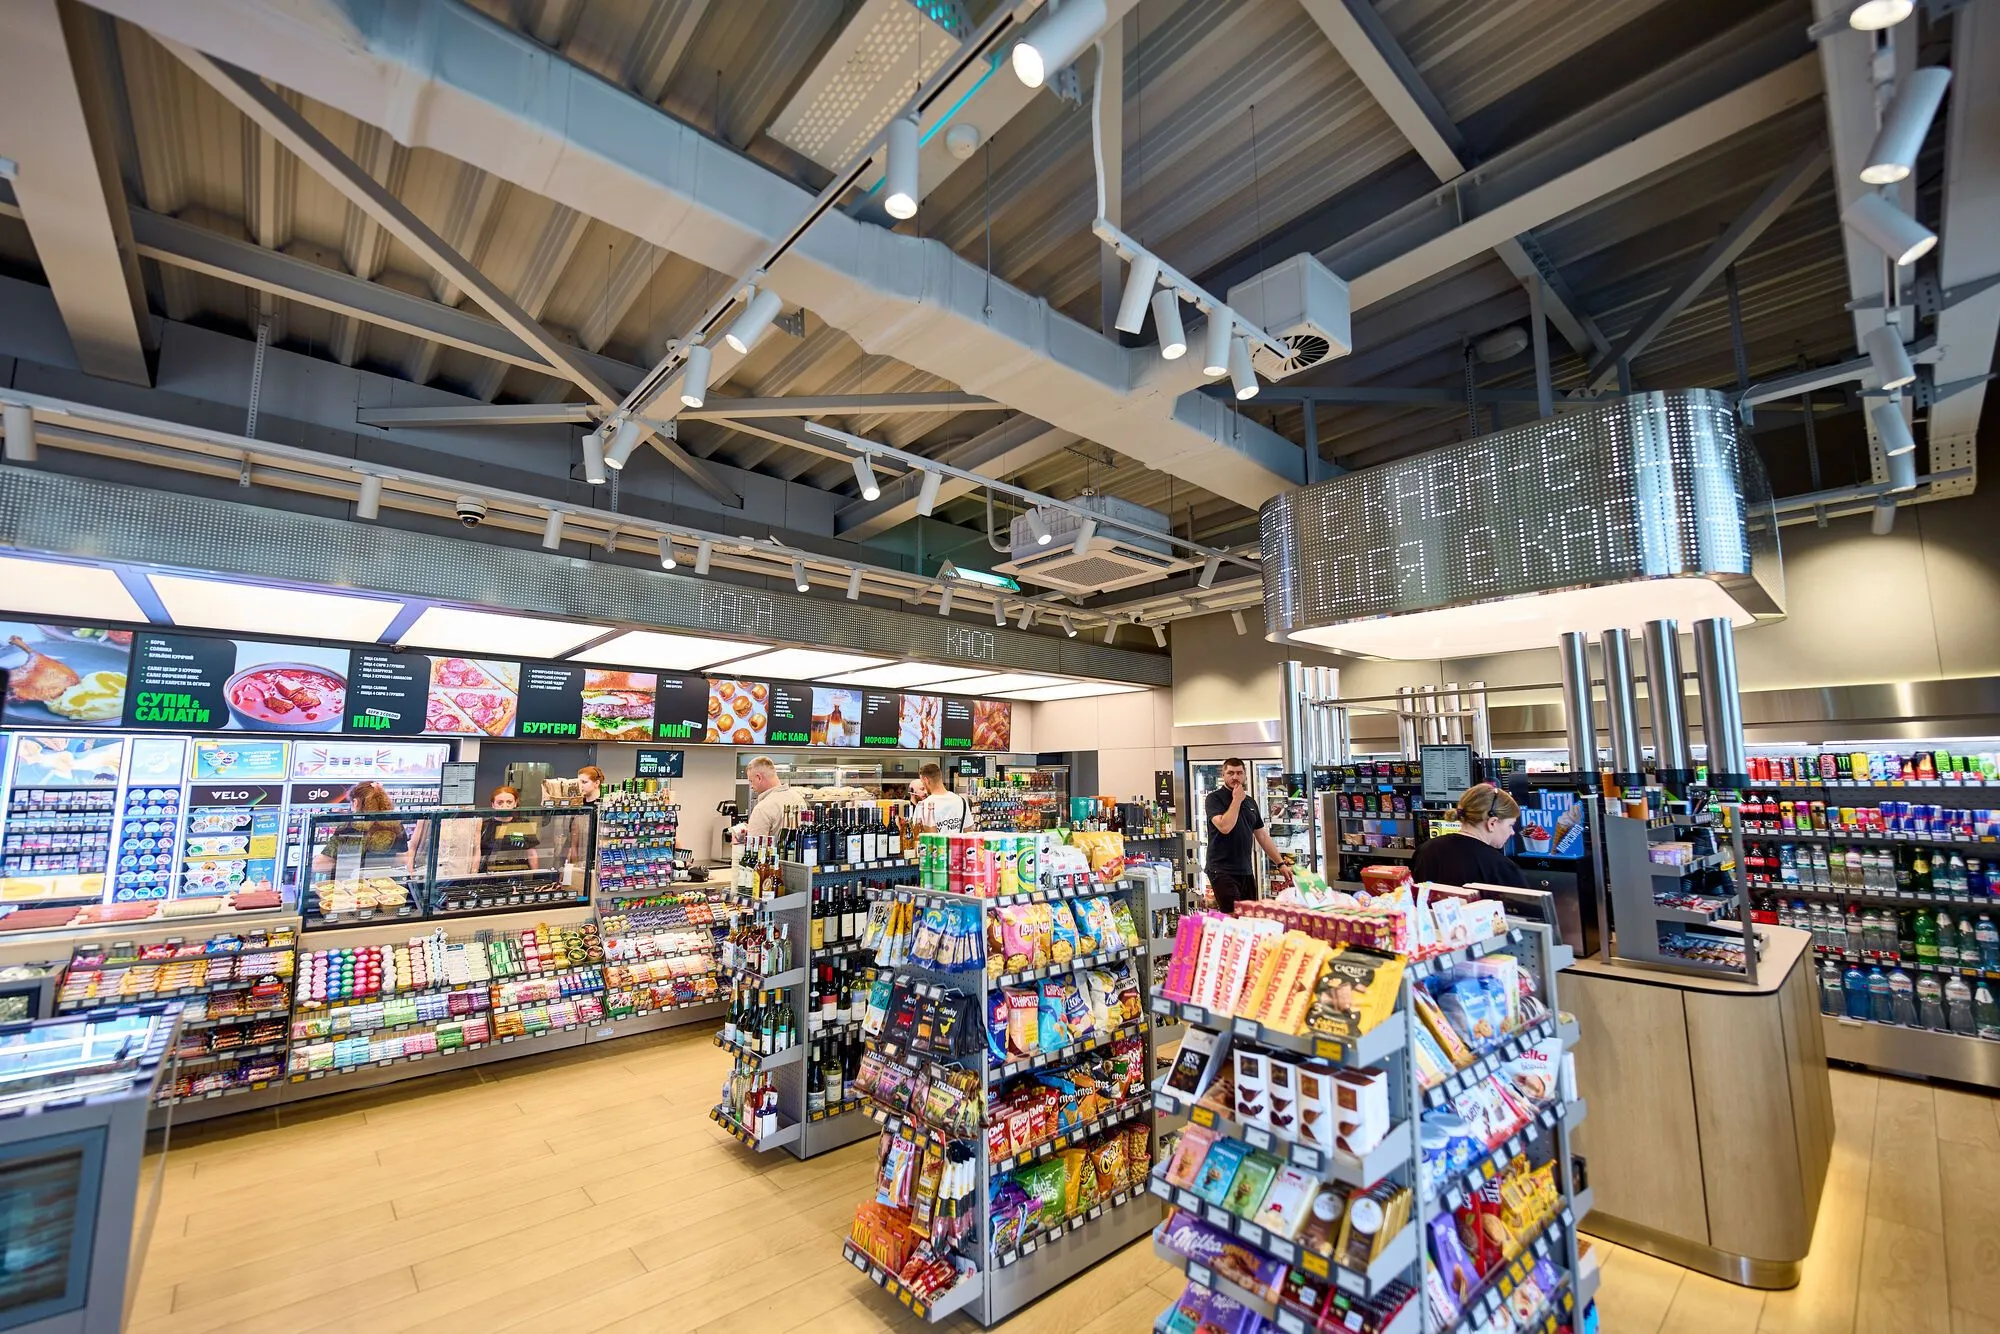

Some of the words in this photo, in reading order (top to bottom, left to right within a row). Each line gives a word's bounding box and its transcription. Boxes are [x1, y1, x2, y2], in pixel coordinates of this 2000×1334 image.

[1363, 449, 1499, 532] КАВА
[1313, 540, 1427, 610] ІДЕЯ
[1518, 491, 1697, 577] КАВА
[700, 587, 773, 630] КАСА
[947, 626, 995, 660] КАСА
[137, 692, 191, 708] СУПИ
[191, 700, 200, 708] &
[135, 707, 210, 723] САЛАТИ
[353, 715, 391, 730] ПІЦА
[523, 721, 577, 735] БУРГЕРИ
[660, 723, 691, 738] МІНІ
[771, 731, 787, 741] АЙС
[788, 732, 809, 742] КАВА
[864, 736, 897, 745] МОРОЗИВО
[944, 738, 972, 747] ВИПІЧКА
[211, 791, 249, 800] VELO
[308, 788, 330, 801] glo
[1541, 789, 1574, 811] ЇСТИ
[1521, 806, 1553, 827] ЇСТИ
[1556, 824, 1585, 853] МОРОЗИВО
[1196, 931, 1216, 1004] TOBLERONE
[1212, 933, 1232, 1008] TOBLERONE
[1222, 937, 1246, 1012] TOBLERONE
[1257, 946, 1296, 1020] TOBLERONE
[1033, 1180, 1052, 1193] RICE
[1173, 1225, 1225, 1253] Milka
